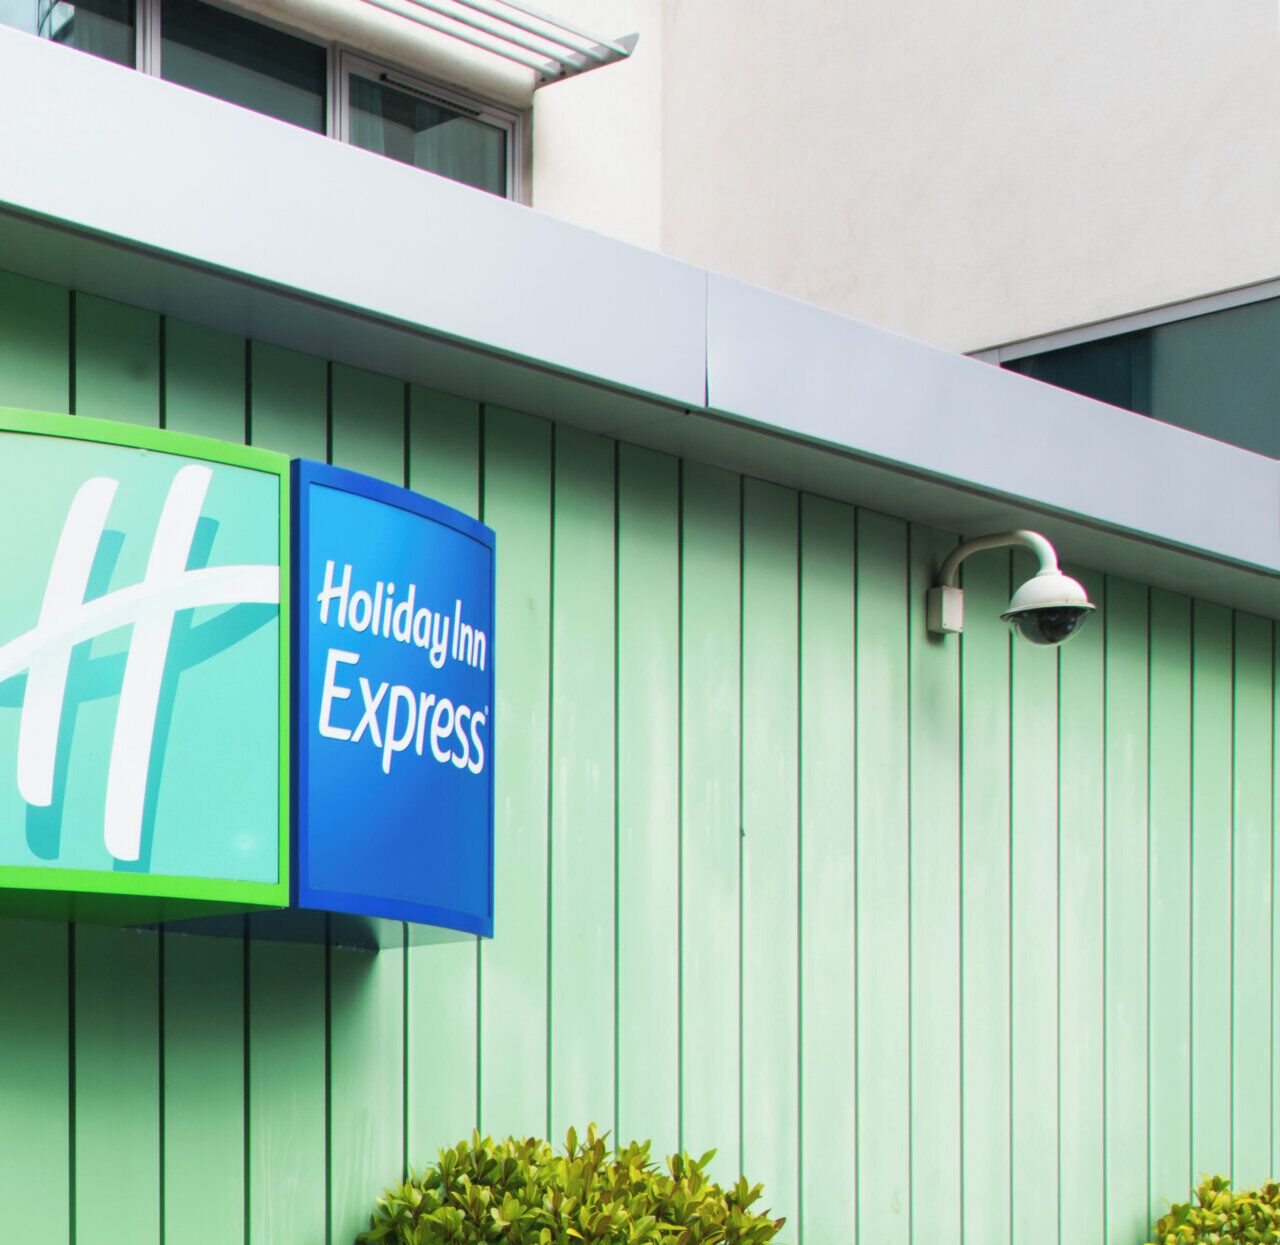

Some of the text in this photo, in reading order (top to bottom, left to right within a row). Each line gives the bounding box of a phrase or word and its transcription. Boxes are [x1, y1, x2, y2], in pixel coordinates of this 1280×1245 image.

[317, 560, 486, 672] Holiday Inn
[318, 648, 486, 775] Express
